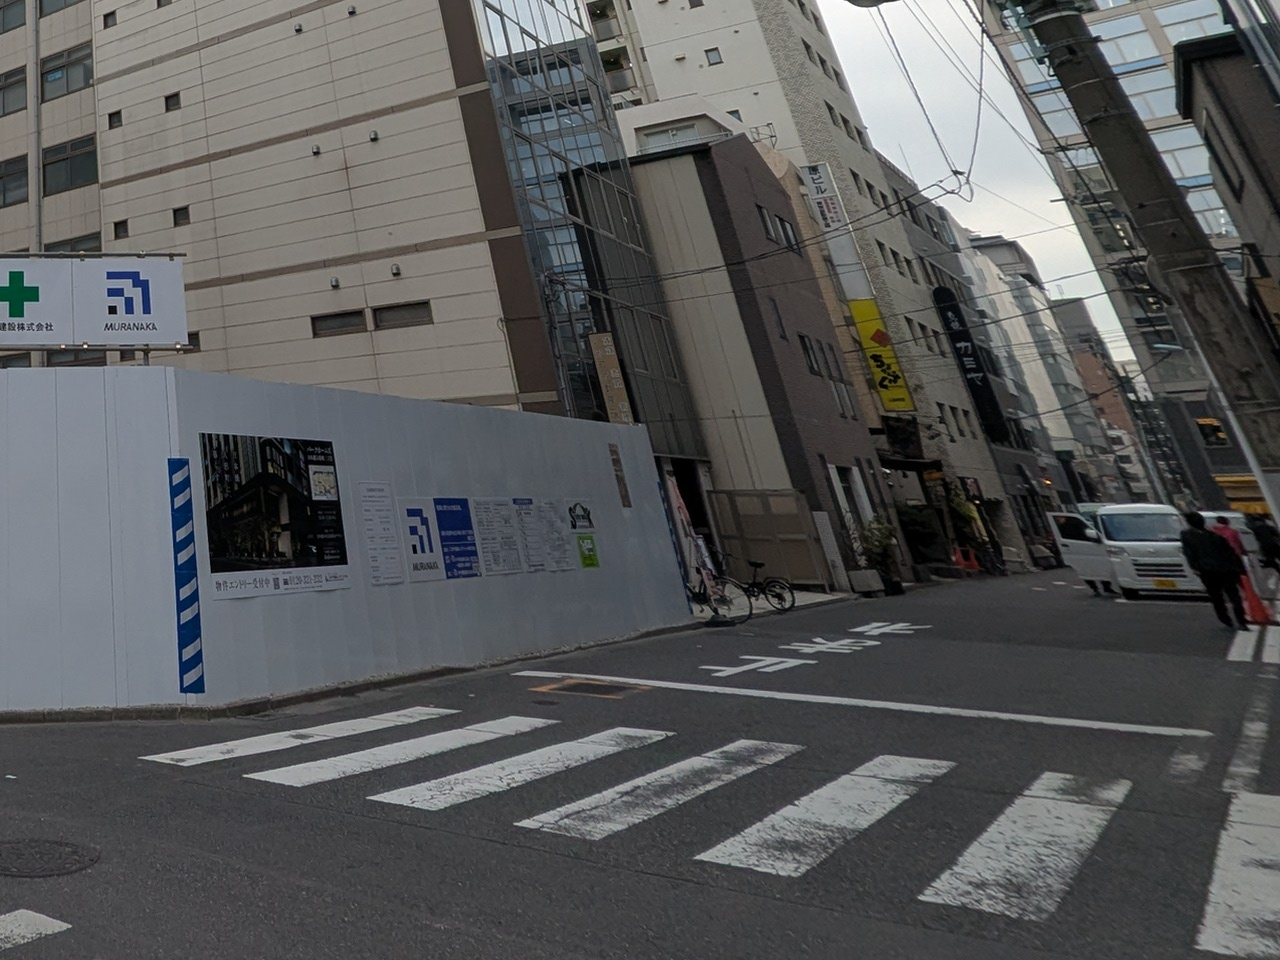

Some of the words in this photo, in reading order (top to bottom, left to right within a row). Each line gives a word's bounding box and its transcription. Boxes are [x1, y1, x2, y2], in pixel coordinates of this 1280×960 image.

[103, 322, 158, 332] MURANAKA
[955, 341, 984, 386] カミヤ
[412, 561, 440, 572] MURANAKA
[215, 577, 271, 592] 物件エントリー受付中
[699, 622, 933, 677] 止まれ
